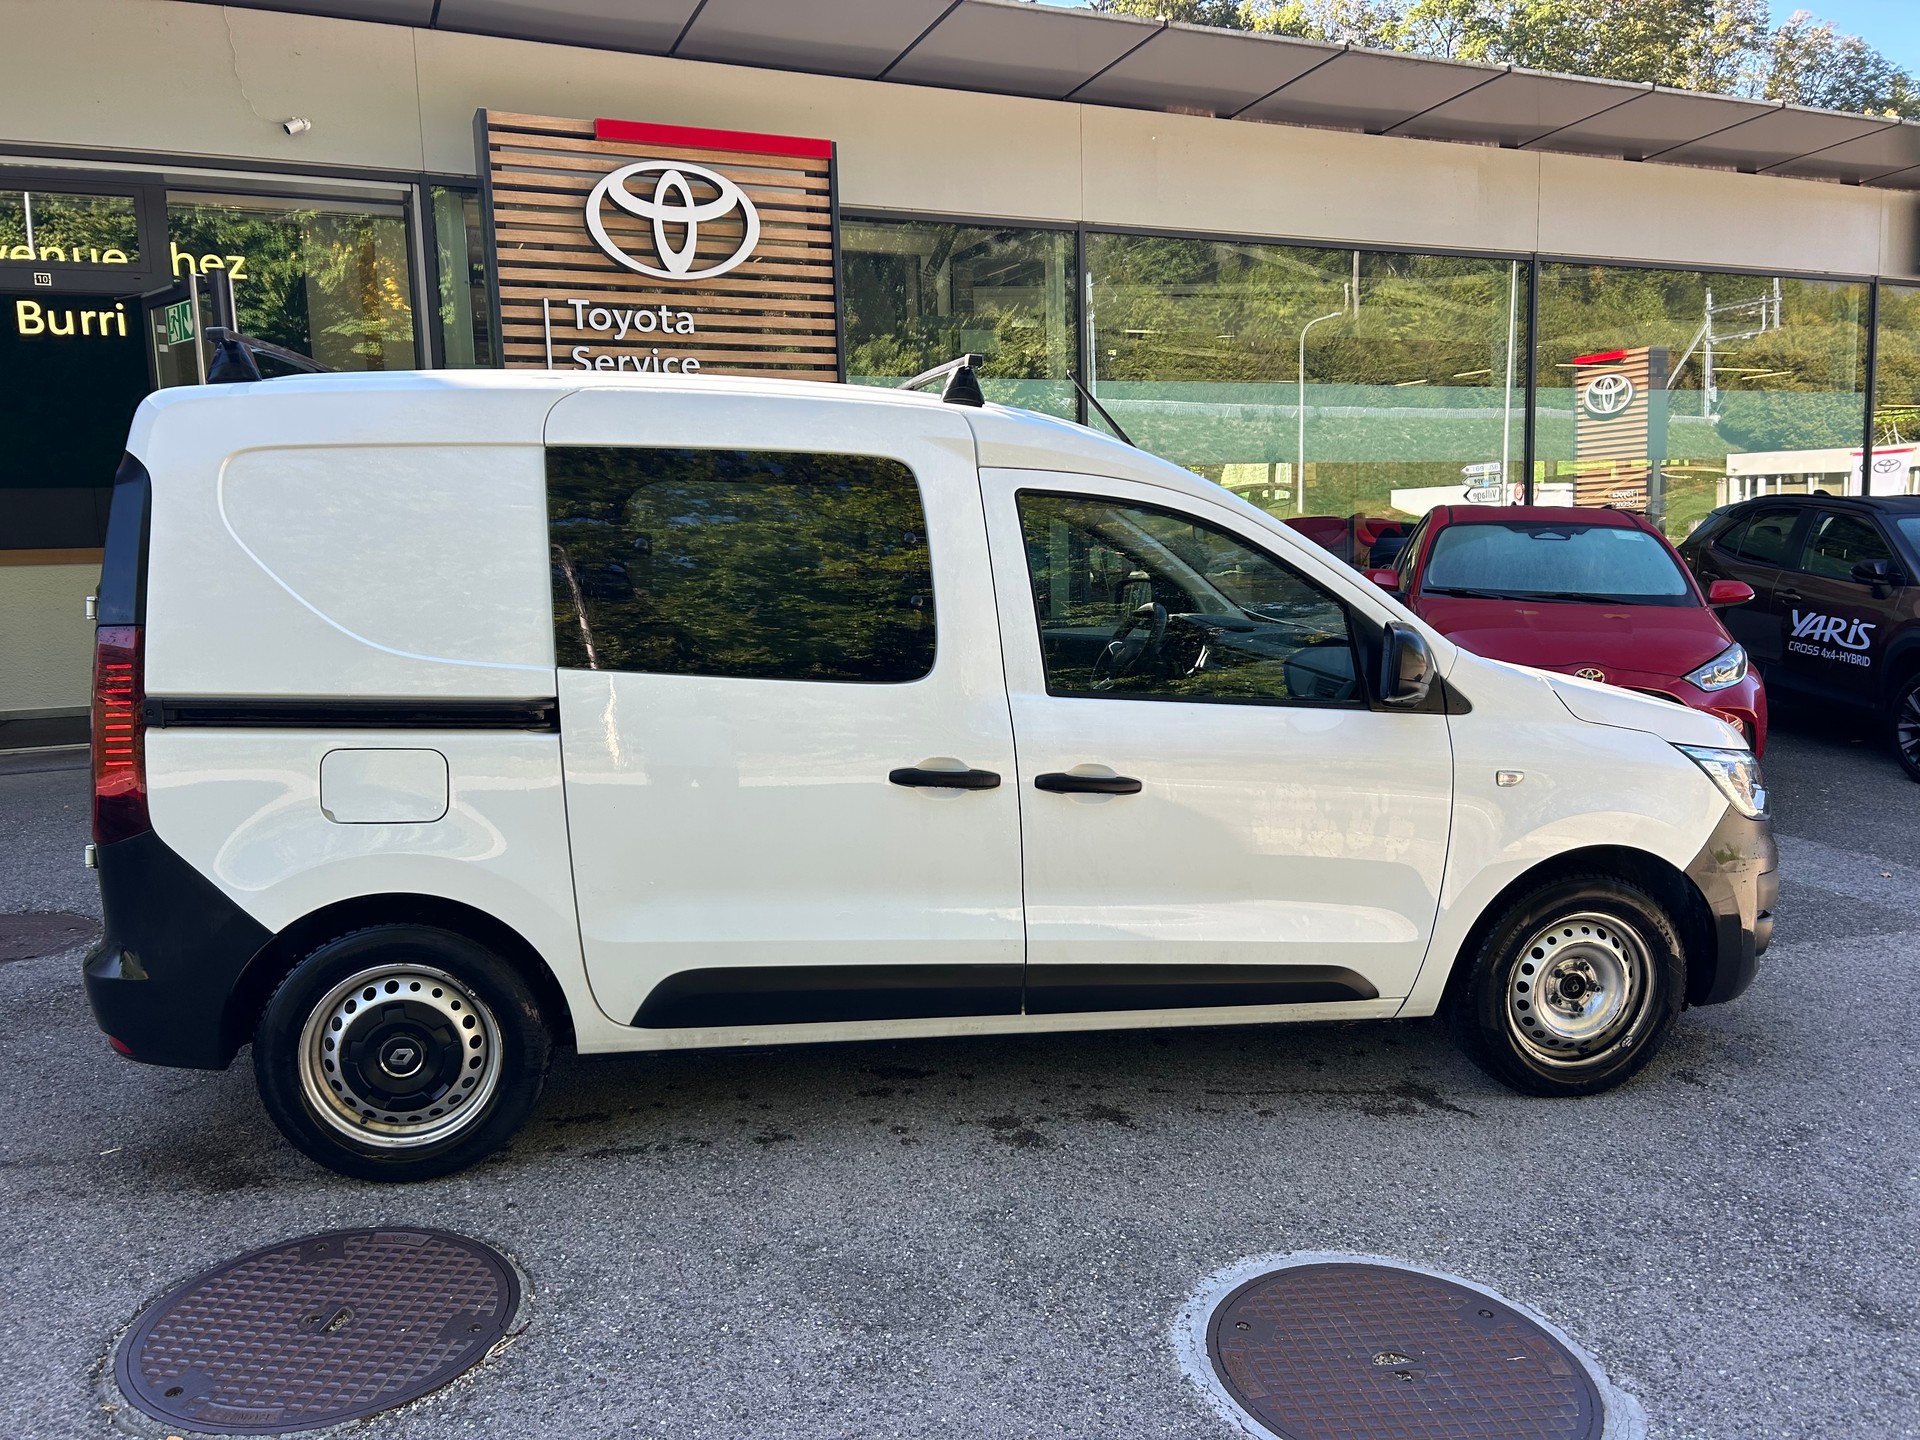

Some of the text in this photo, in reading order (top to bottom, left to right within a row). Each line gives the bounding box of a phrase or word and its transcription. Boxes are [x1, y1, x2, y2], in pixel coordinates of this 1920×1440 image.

[170, 241, 248, 280] hez
[37, 275, 49, 284] 10
[15, 299, 127, 337] Burri
[567, 298, 695, 340] Toyota
[571, 345, 701, 374] Service
[1788, 640, 1871, 667] CROSS 4x4-HYBRID
